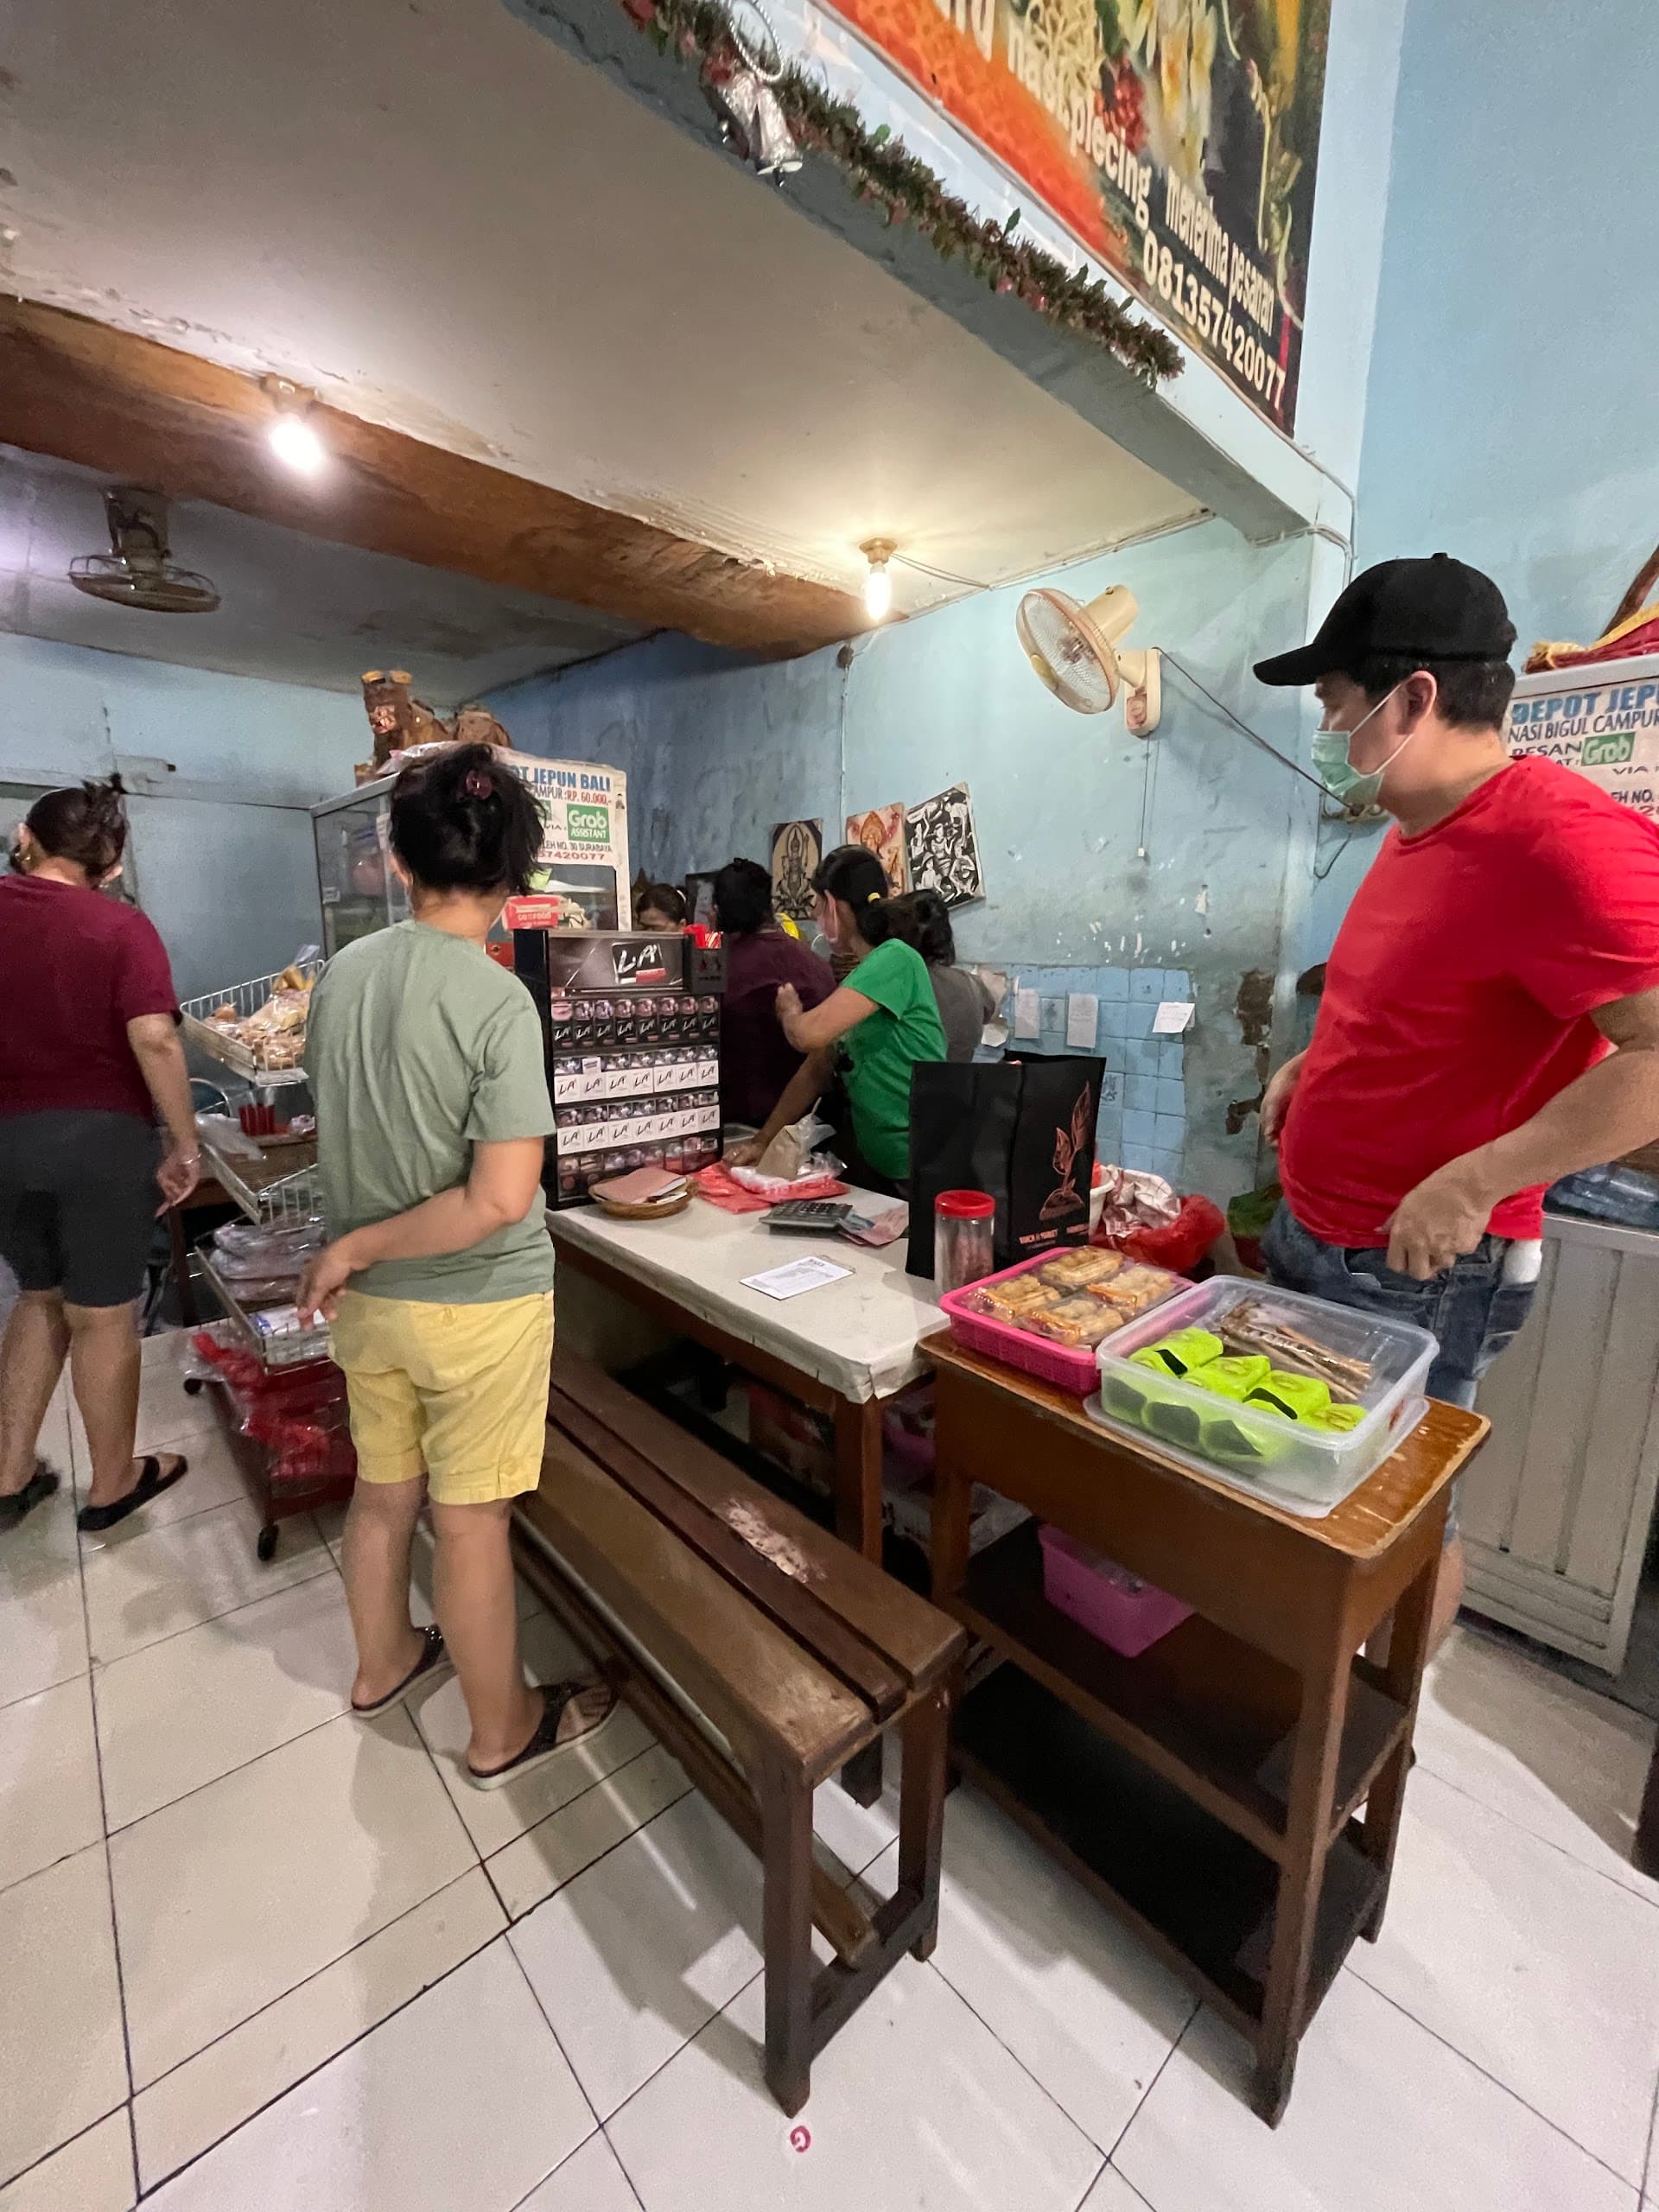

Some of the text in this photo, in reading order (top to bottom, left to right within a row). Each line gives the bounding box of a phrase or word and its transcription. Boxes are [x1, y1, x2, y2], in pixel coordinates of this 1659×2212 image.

[1165, 164, 1274, 337] menerima pesanan
[1143, 229, 1287, 410] 081357420077
[1512, 692, 1602, 725] DEPOT
[1508, 724, 1543, 743] NASI
[1545, 716, 1589, 740] BIGUL
[1584, 737, 1630, 765] Grab
[531, 766, 576, 788] JEPUN
[581, 773, 611, 792] BALI
[1612, 766, 1649, 774] VIA
[532, 784, 563, 800] AMPUR
[568, 810, 607, 829] Grab
[570, 827, 607, 839] ASSISTANT
